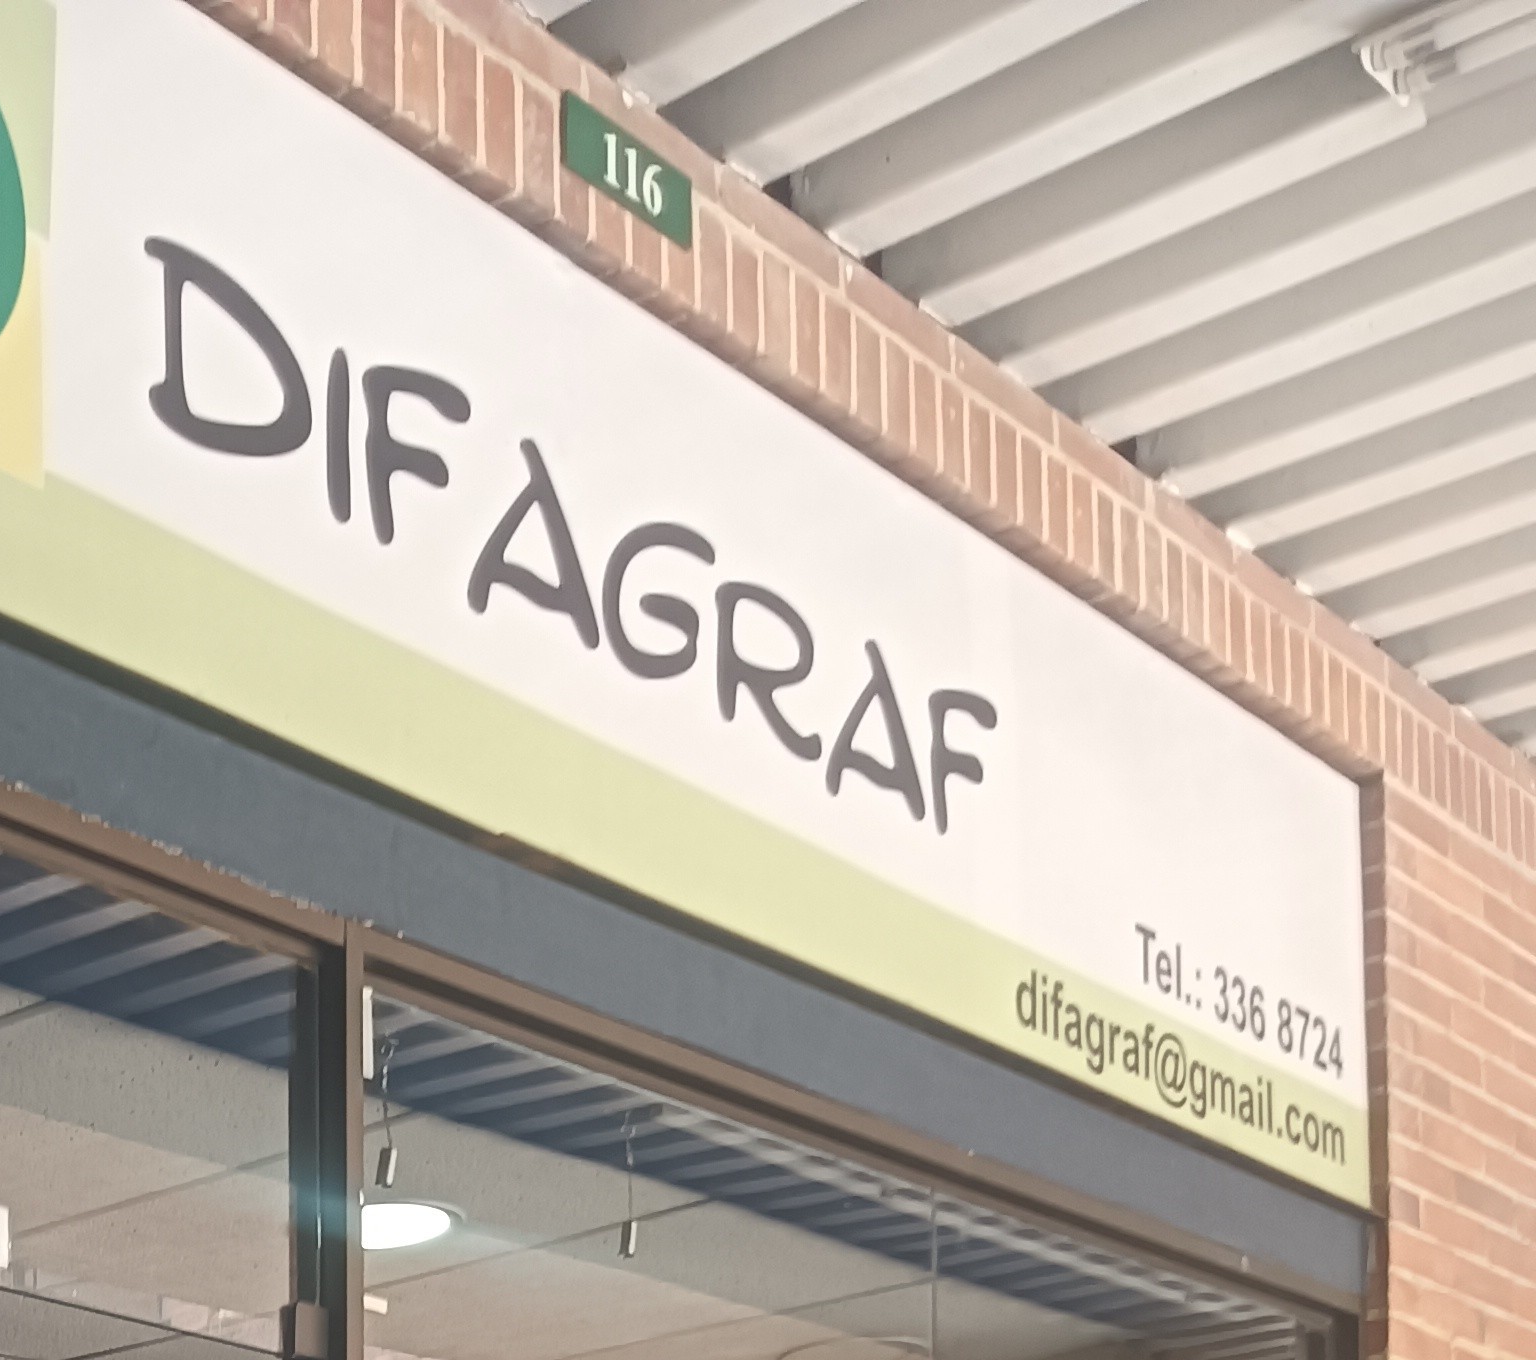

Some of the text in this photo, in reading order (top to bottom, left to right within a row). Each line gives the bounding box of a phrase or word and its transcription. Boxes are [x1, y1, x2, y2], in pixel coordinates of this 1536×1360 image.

[603, 133, 663, 217] 116
[144, 236, 998, 834] DIFAGRAF
[1015, 969, 1347, 1165] difagraf@gmail.com
[1135, 922, 1344, 1079] Tel.: 336 8724
